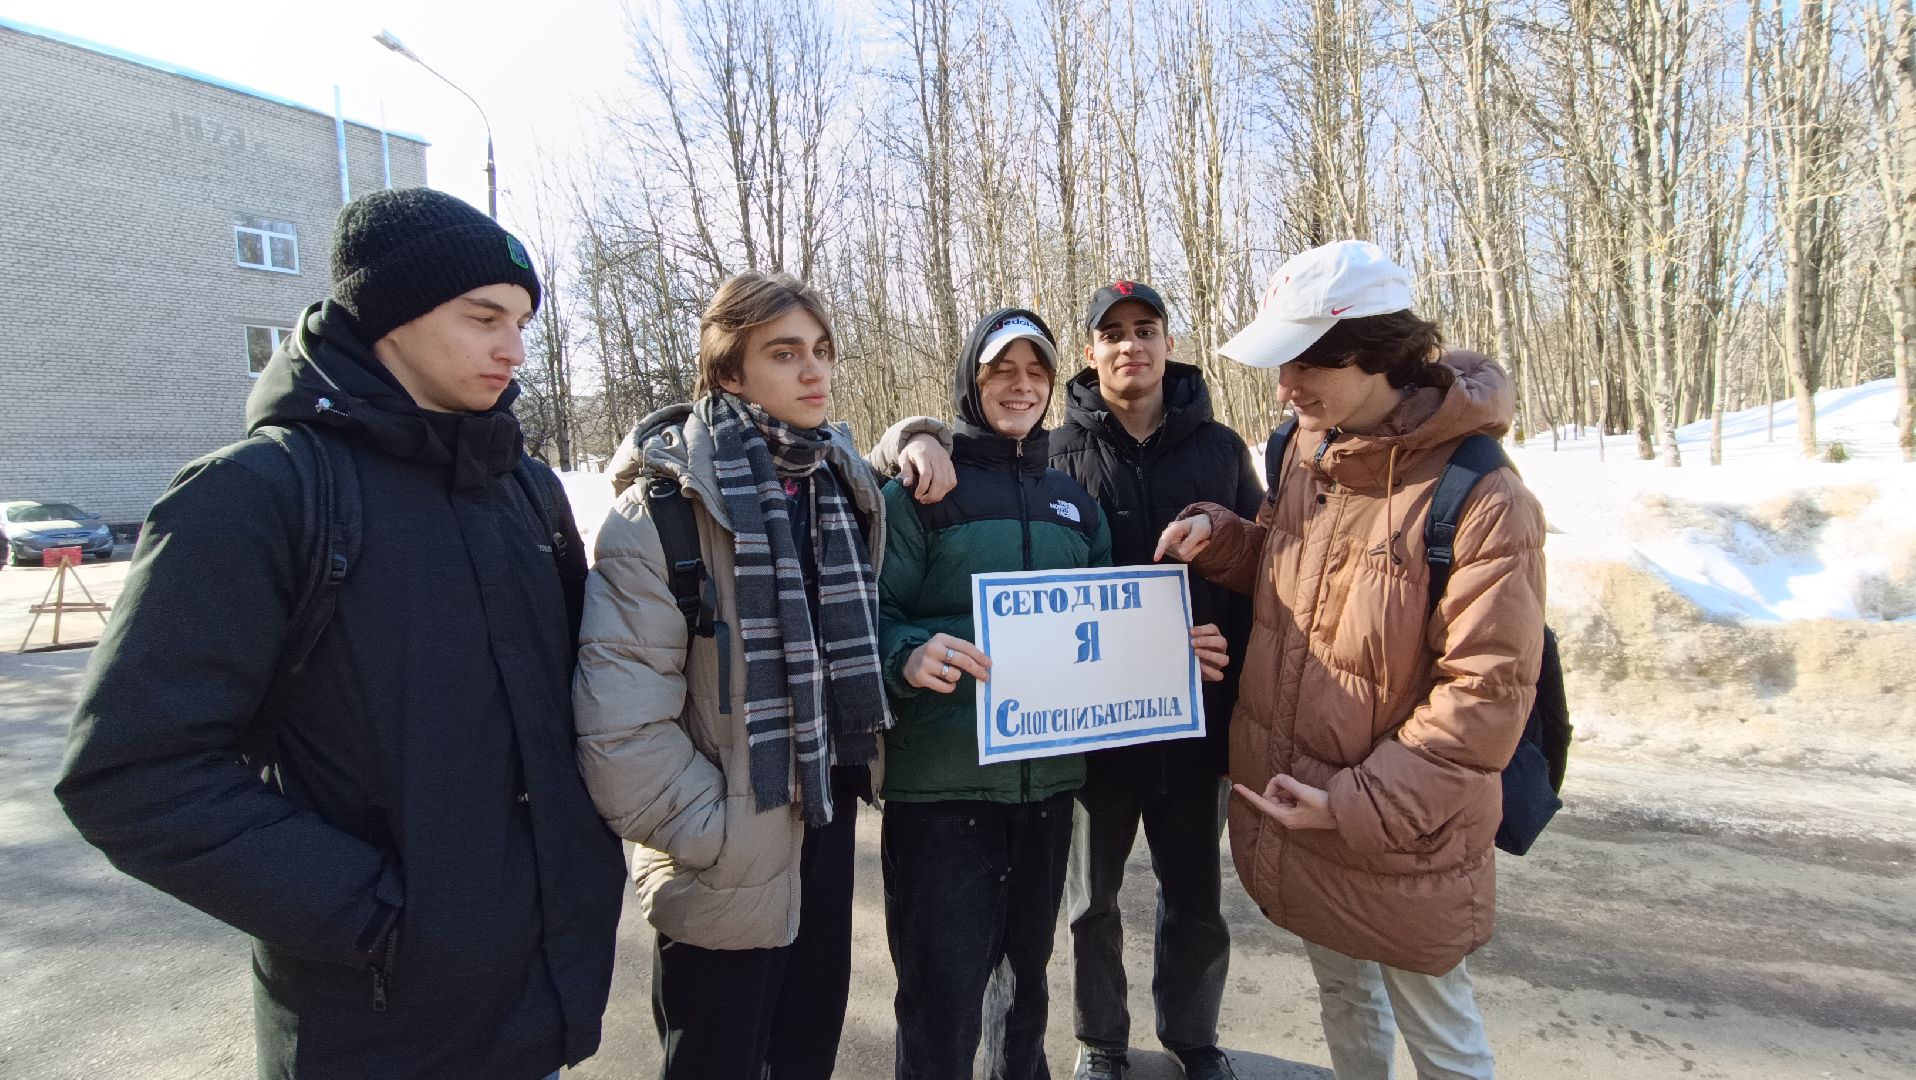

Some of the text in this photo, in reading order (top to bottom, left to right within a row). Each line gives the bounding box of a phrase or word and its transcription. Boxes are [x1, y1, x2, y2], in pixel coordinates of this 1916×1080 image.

[168, 110, 247, 153] 1973
[992, 581, 1143, 617] СЕГОДНЯ
[1072, 620, 1102, 664] Я
